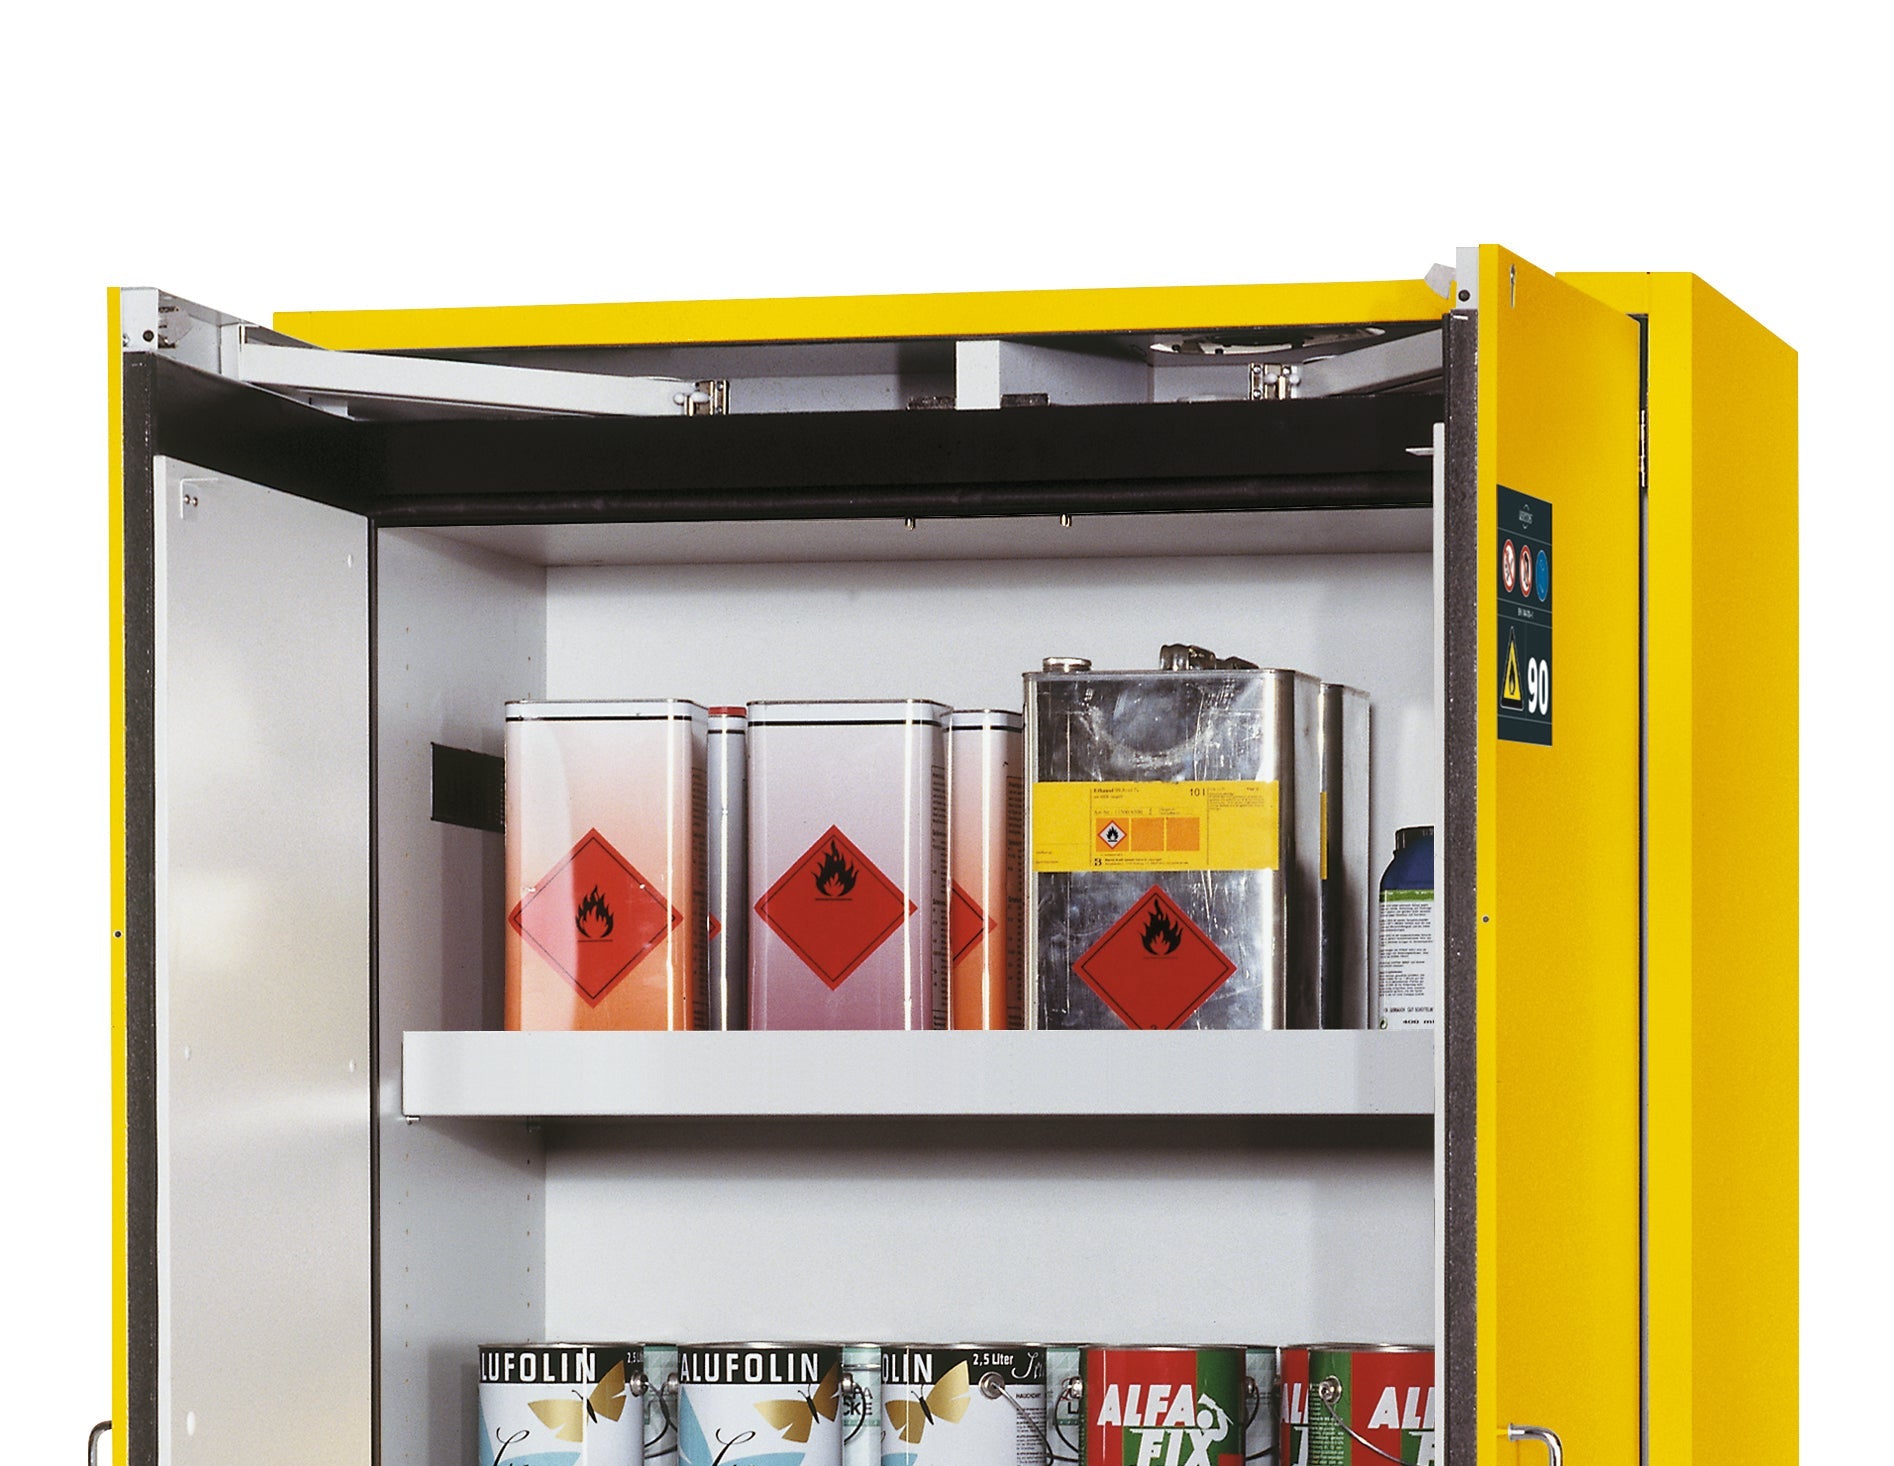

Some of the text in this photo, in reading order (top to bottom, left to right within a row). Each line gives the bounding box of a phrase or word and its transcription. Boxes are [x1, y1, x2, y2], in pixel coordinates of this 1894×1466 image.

[1527, 657, 1549, 716] 90
[680, 1352, 818, 1383] ALUFOLIN
[973, 1352, 990, 1367] 2,5
[991, 1352, 1014, 1366] Liter
[1097, 1383, 1197, 1427] ALFA
